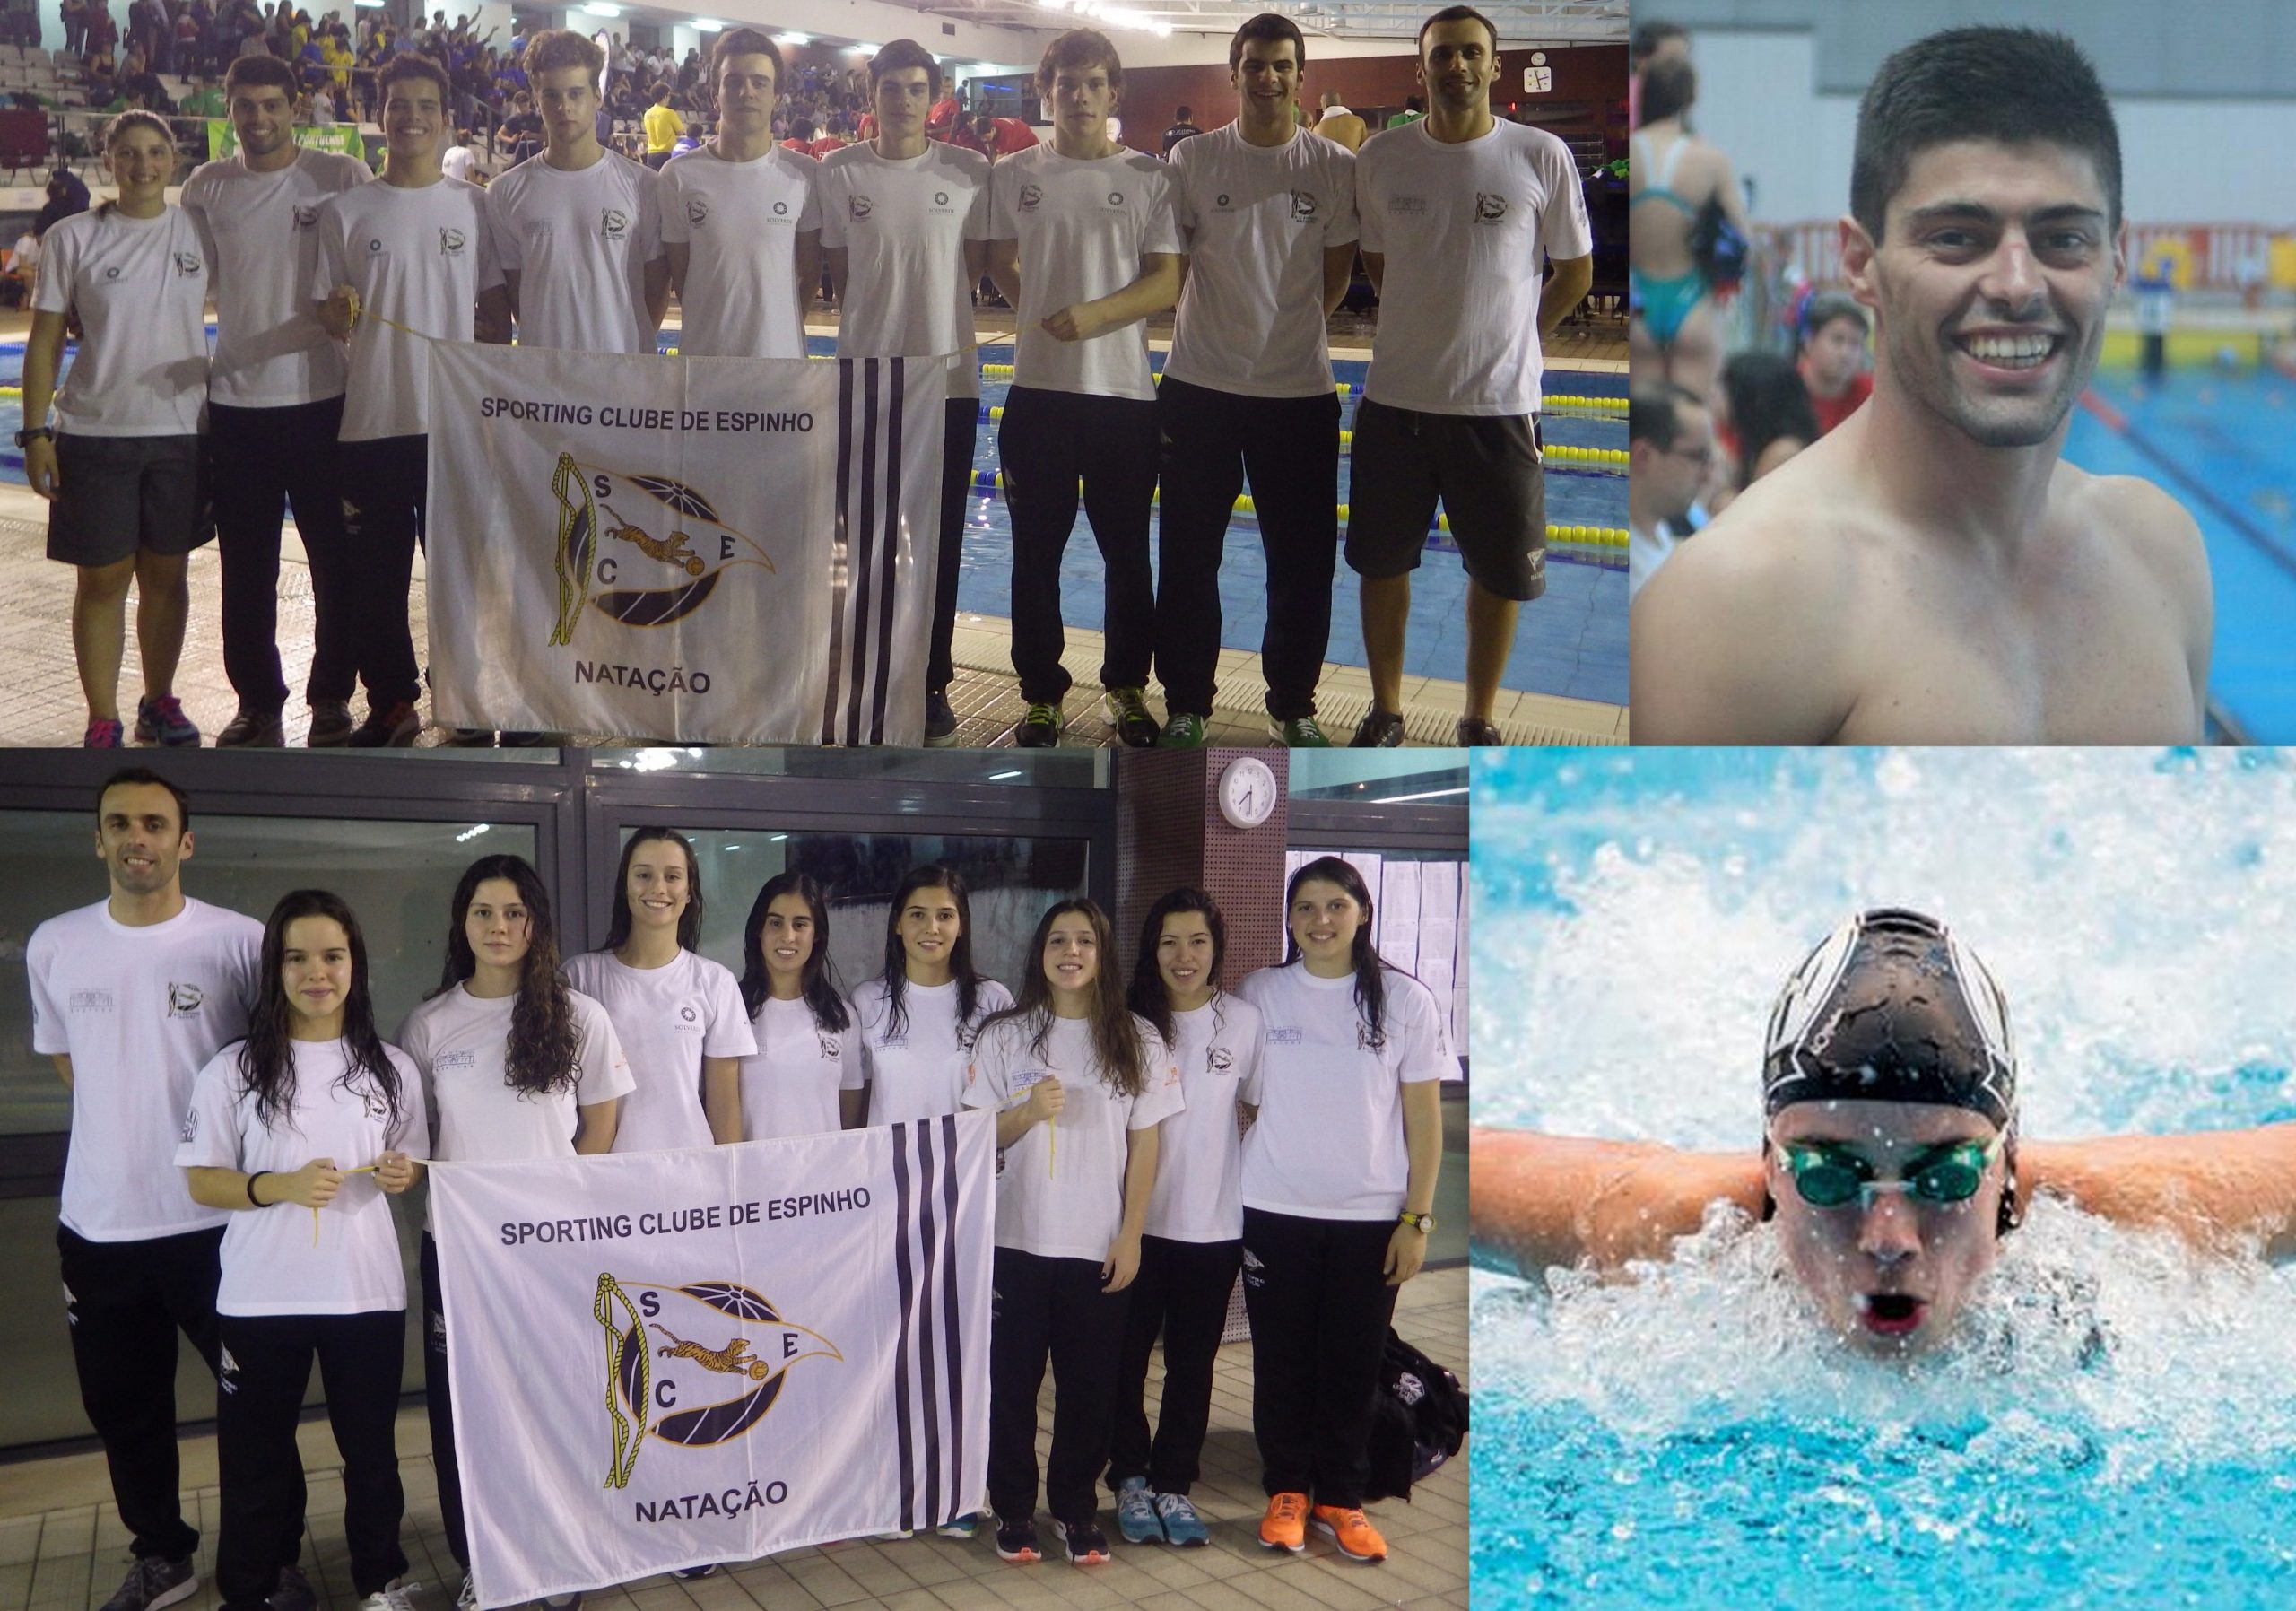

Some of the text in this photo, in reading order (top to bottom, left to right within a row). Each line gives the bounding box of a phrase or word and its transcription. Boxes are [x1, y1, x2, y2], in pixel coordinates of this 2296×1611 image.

[481, 396, 813, 432] SPORTING CLUBE DE ESPINHO
[594, 475, 612, 499] S
[719, 535, 736, 561] E
[596, 557, 618, 585] C
[574, 660, 711, 697] NATAÇÃO
[500, 1186, 871, 1246] SPORTING CLUBE DE ESPINHO
[639, 1291, 661, 1318] S
[782, 1332, 799, 1359] E
[655, 1379, 677, 1408] C
[635, 1479, 788, 1523] NATAÇÃO
